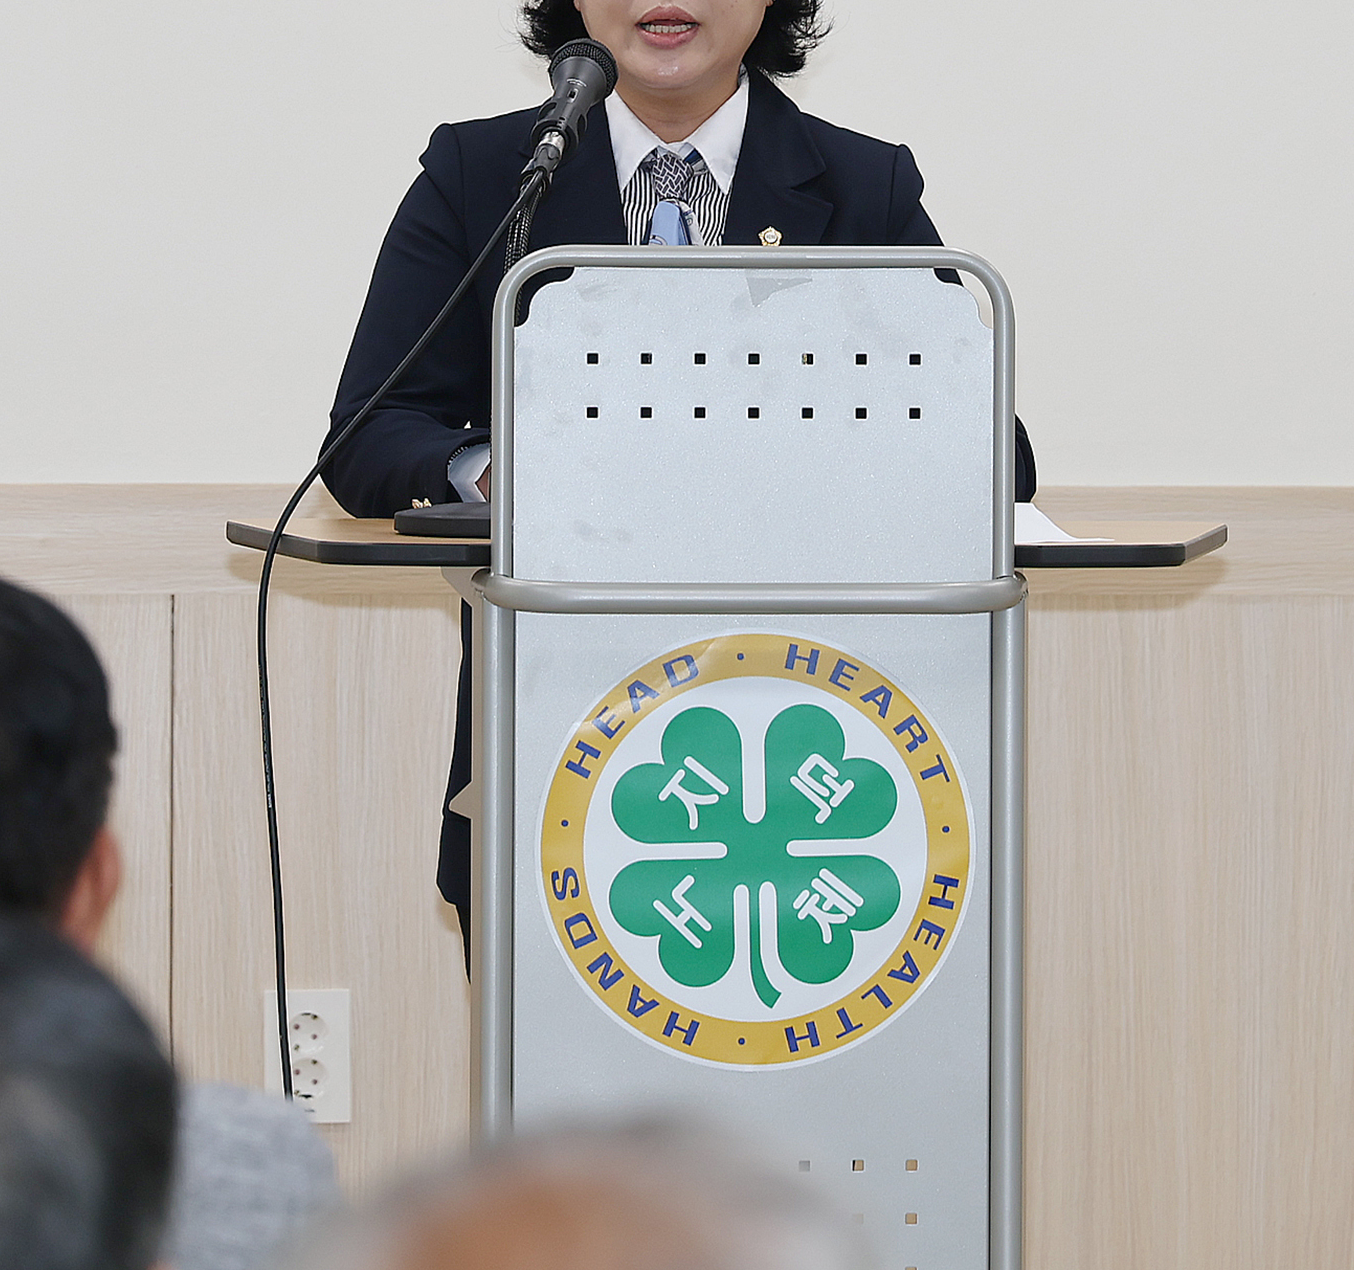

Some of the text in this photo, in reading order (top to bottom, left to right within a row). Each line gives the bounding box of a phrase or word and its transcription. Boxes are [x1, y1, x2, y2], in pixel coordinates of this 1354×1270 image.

[658, 755, 729, 830] 지
[551, 643, 960, 1053] HEAD HEART HEALTH HANDS
[652, 875, 712, 948] 노
[793, 868, 864, 944] 체
